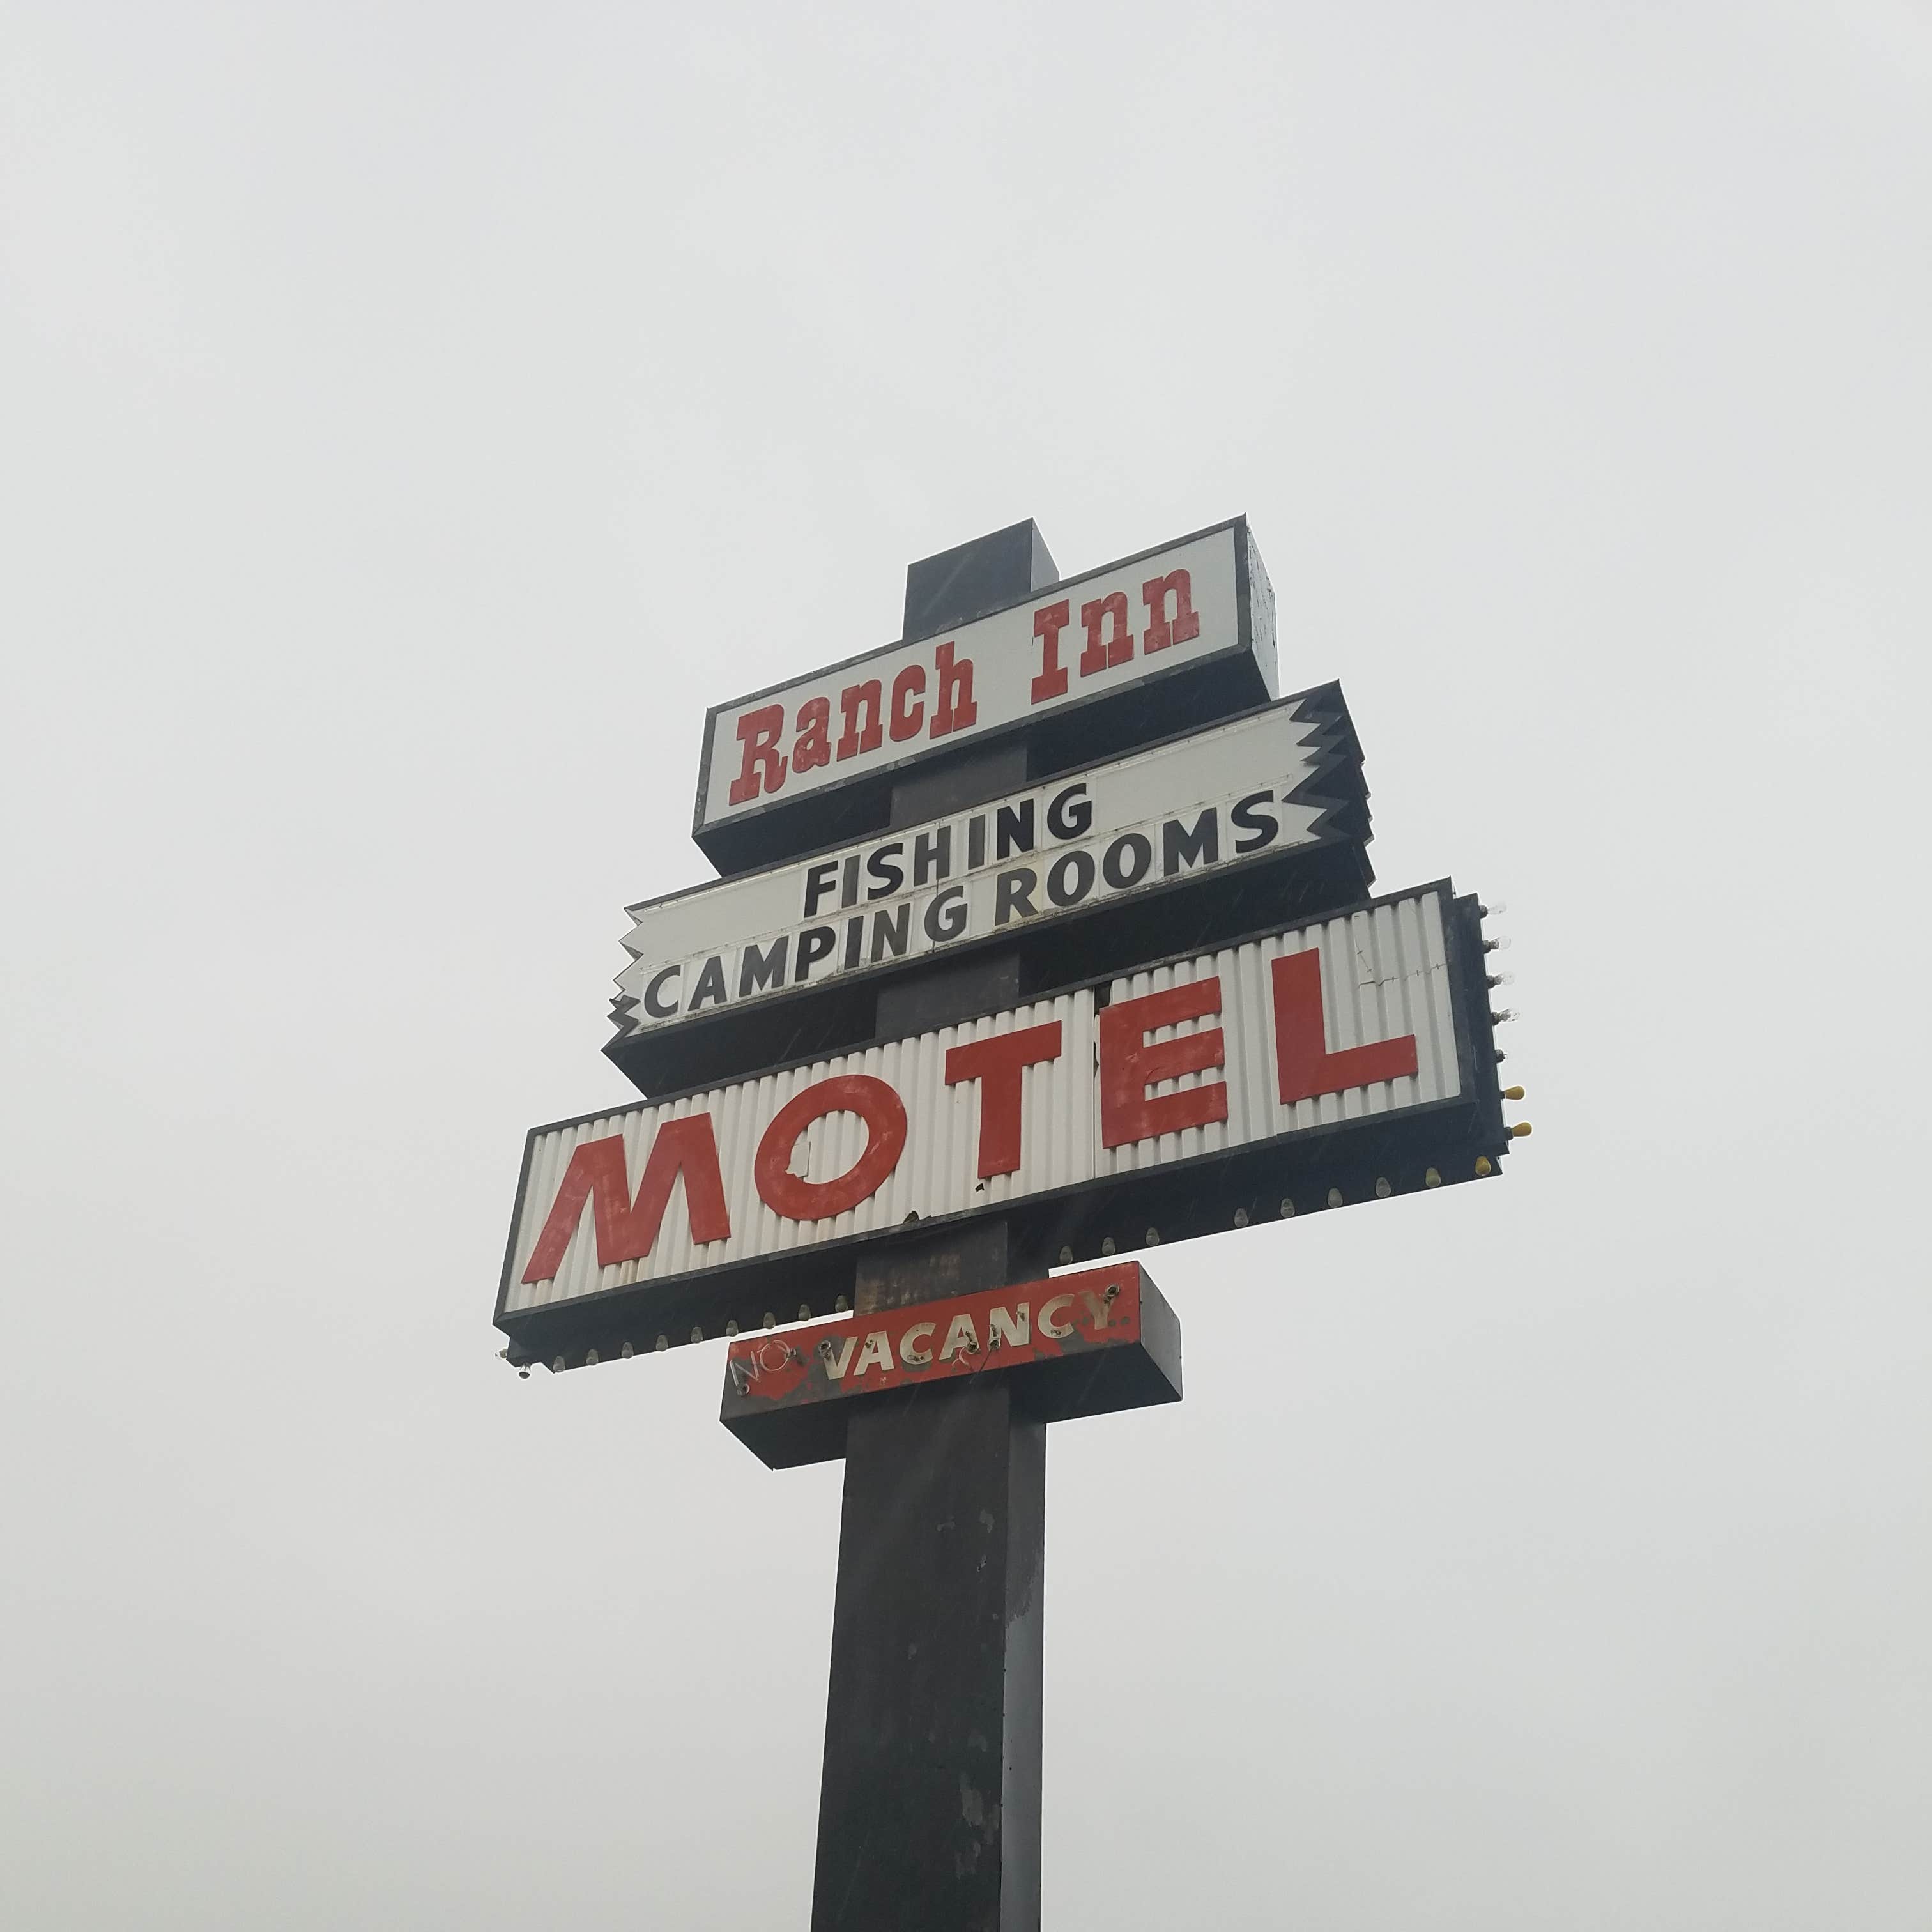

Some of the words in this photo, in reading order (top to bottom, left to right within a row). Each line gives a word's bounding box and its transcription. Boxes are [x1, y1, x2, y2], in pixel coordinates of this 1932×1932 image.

[729, 641, 977, 805] Ranch
[1031, 567, 1200, 705] Inn
[643, 885, 969, 1018] CAMPING
[993, 790, 1279, 924] ROOMS
[803, 783, 1093, 918] FISHING
[520, 947, 1419, 1284] MOTEL
[728, 1340, 793, 1389] NO
[822, 1287, 1118, 1381] VACANCY
